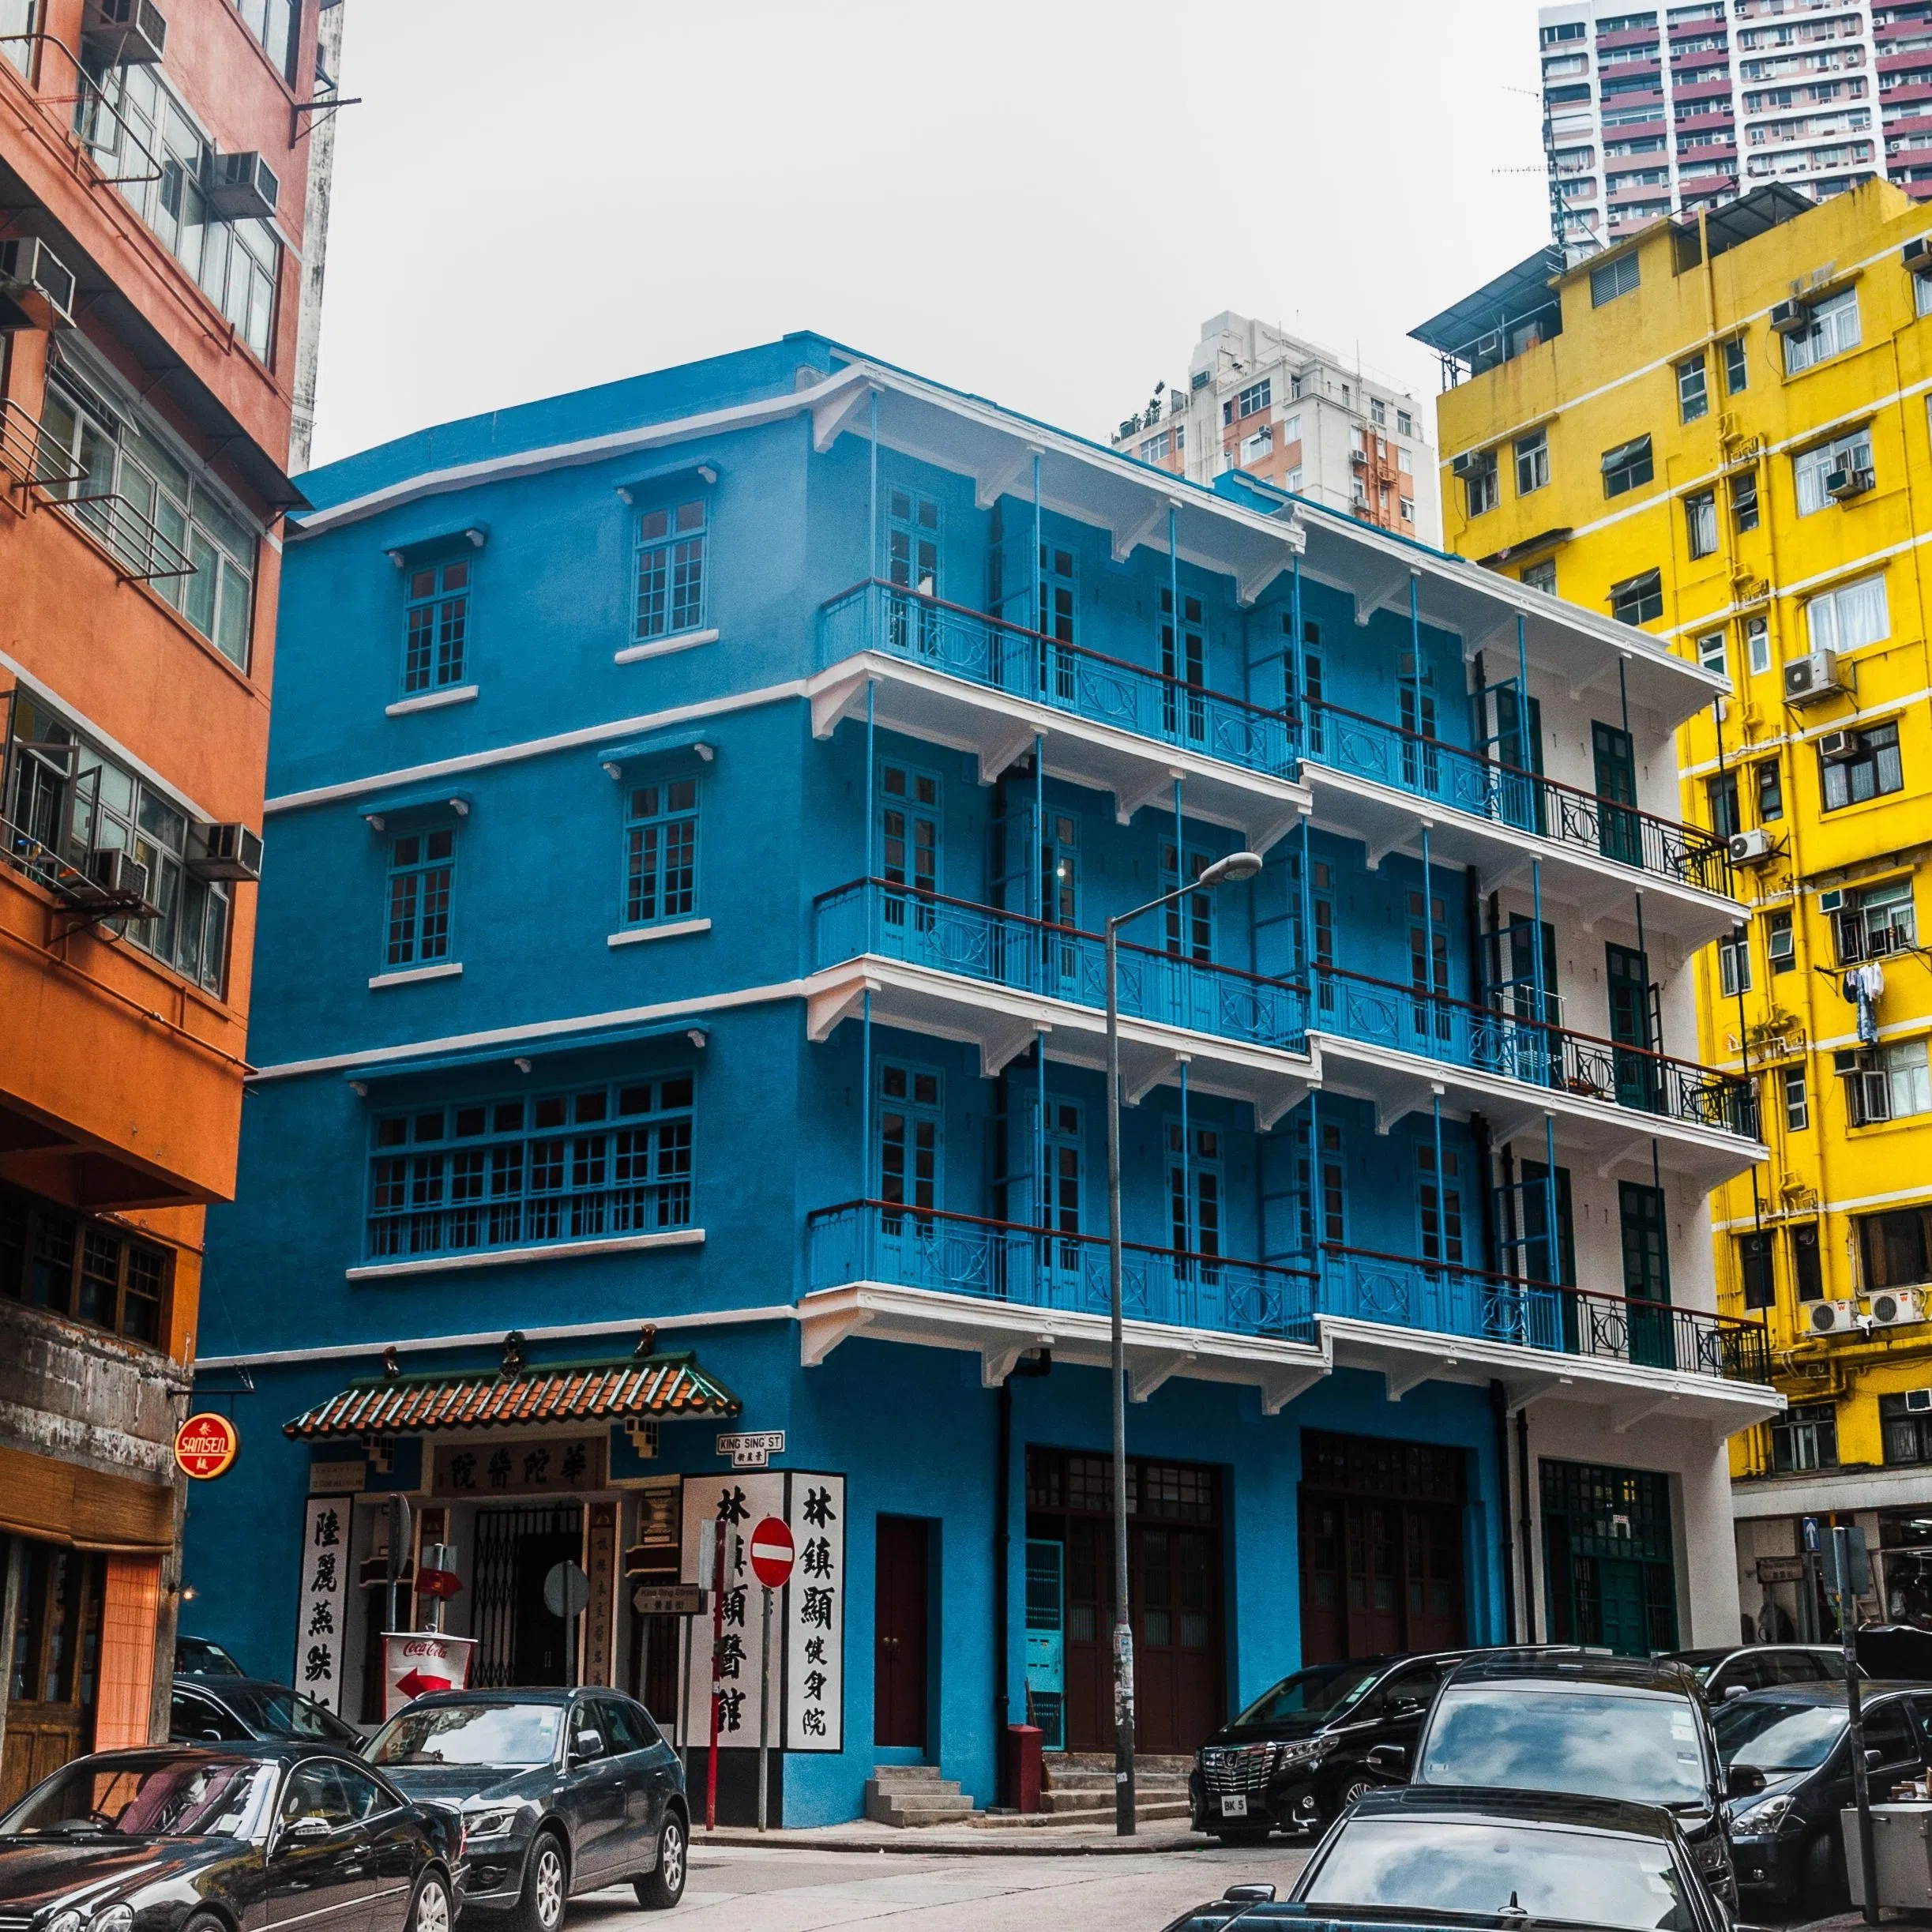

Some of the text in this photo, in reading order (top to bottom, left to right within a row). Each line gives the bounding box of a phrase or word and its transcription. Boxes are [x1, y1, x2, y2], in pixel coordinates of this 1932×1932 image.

[182, 1437, 227, 1453] SAMSEN
[720, 1436, 780, 1449] KING SING ST
[799, 1485, 836, 1736] 林鎮顯健身院
[1224, 1799, 1245, 1811] BK 5
